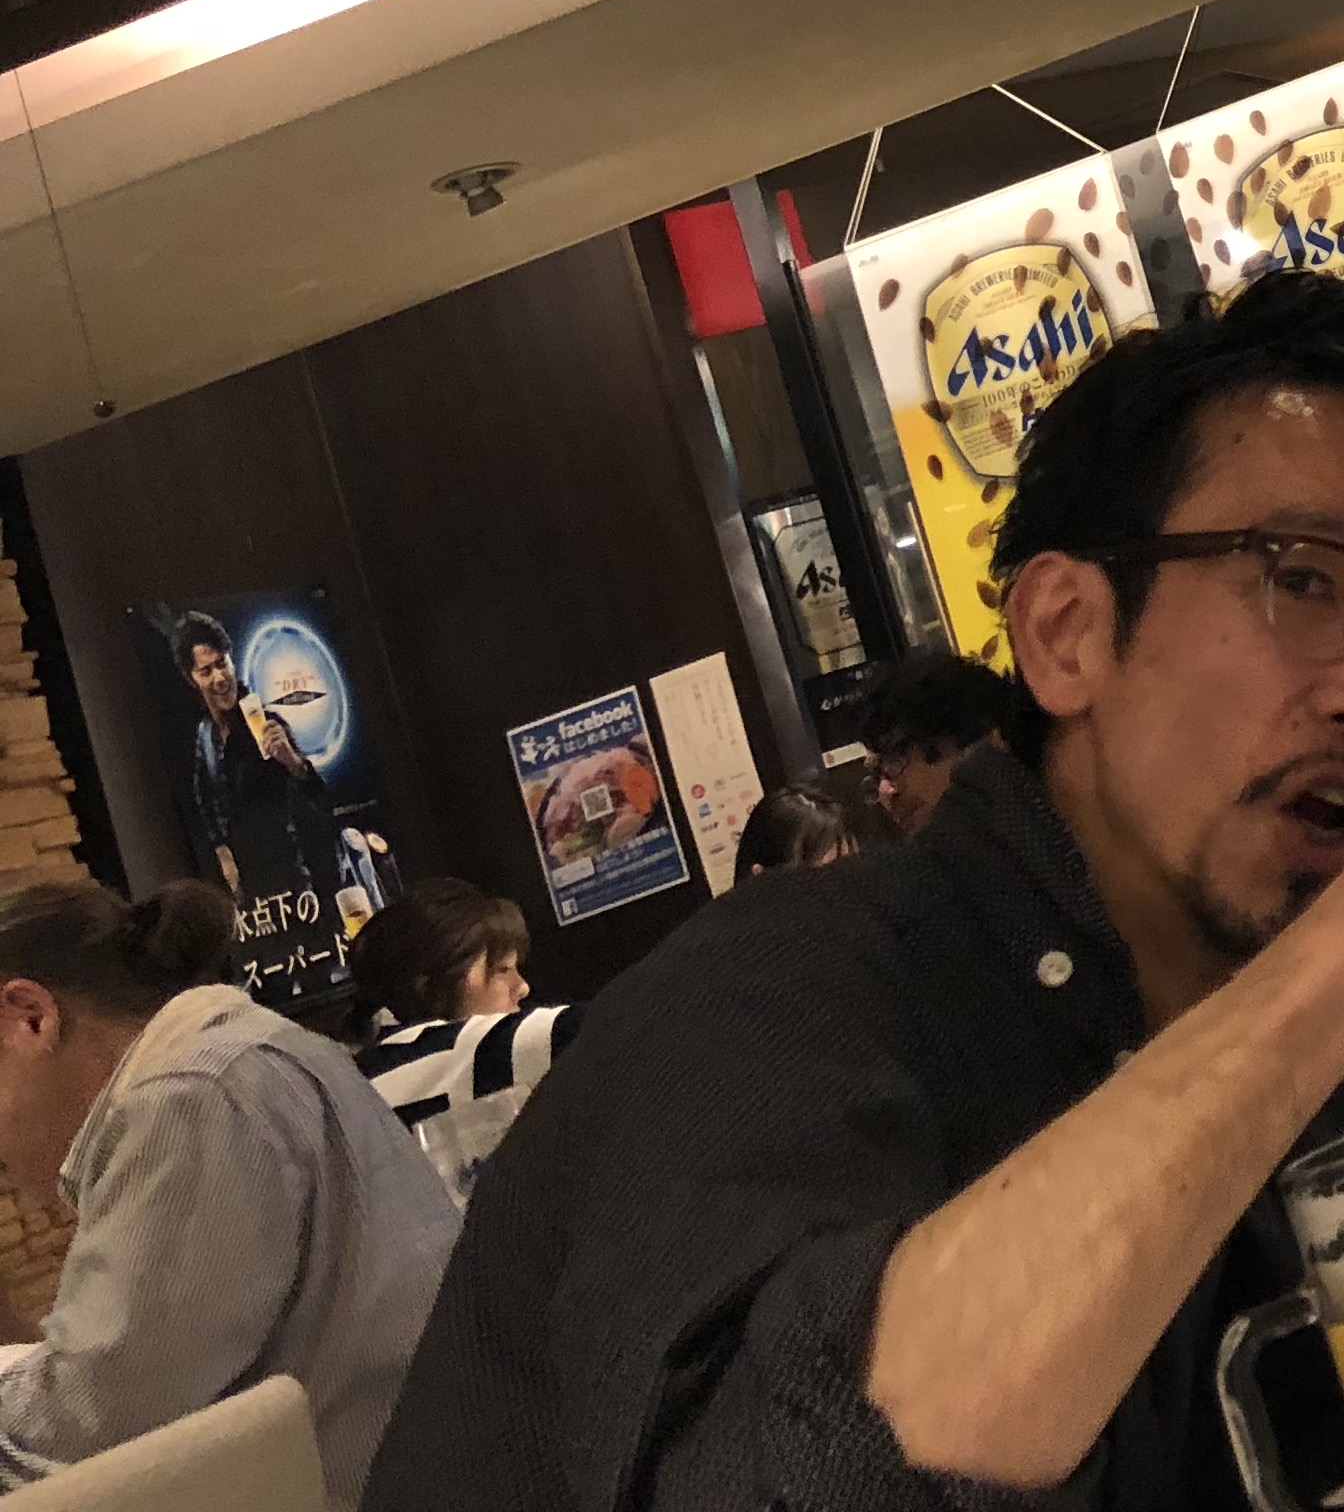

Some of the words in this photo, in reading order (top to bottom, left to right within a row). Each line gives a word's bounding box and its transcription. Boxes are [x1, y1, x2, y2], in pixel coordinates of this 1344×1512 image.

[1265, 178, 1288, 207] ASAHI
[948, 294, 971, 322] ASAHI
[969, 266, 1015, 297] BREWERIE
[1026, 265, 1058, 288] IMITED
[947, 288, 1094, 398] Asahi
[982, 363, 1077, 409] 100年のこわり
[559, 700, 633, 739] facebook
